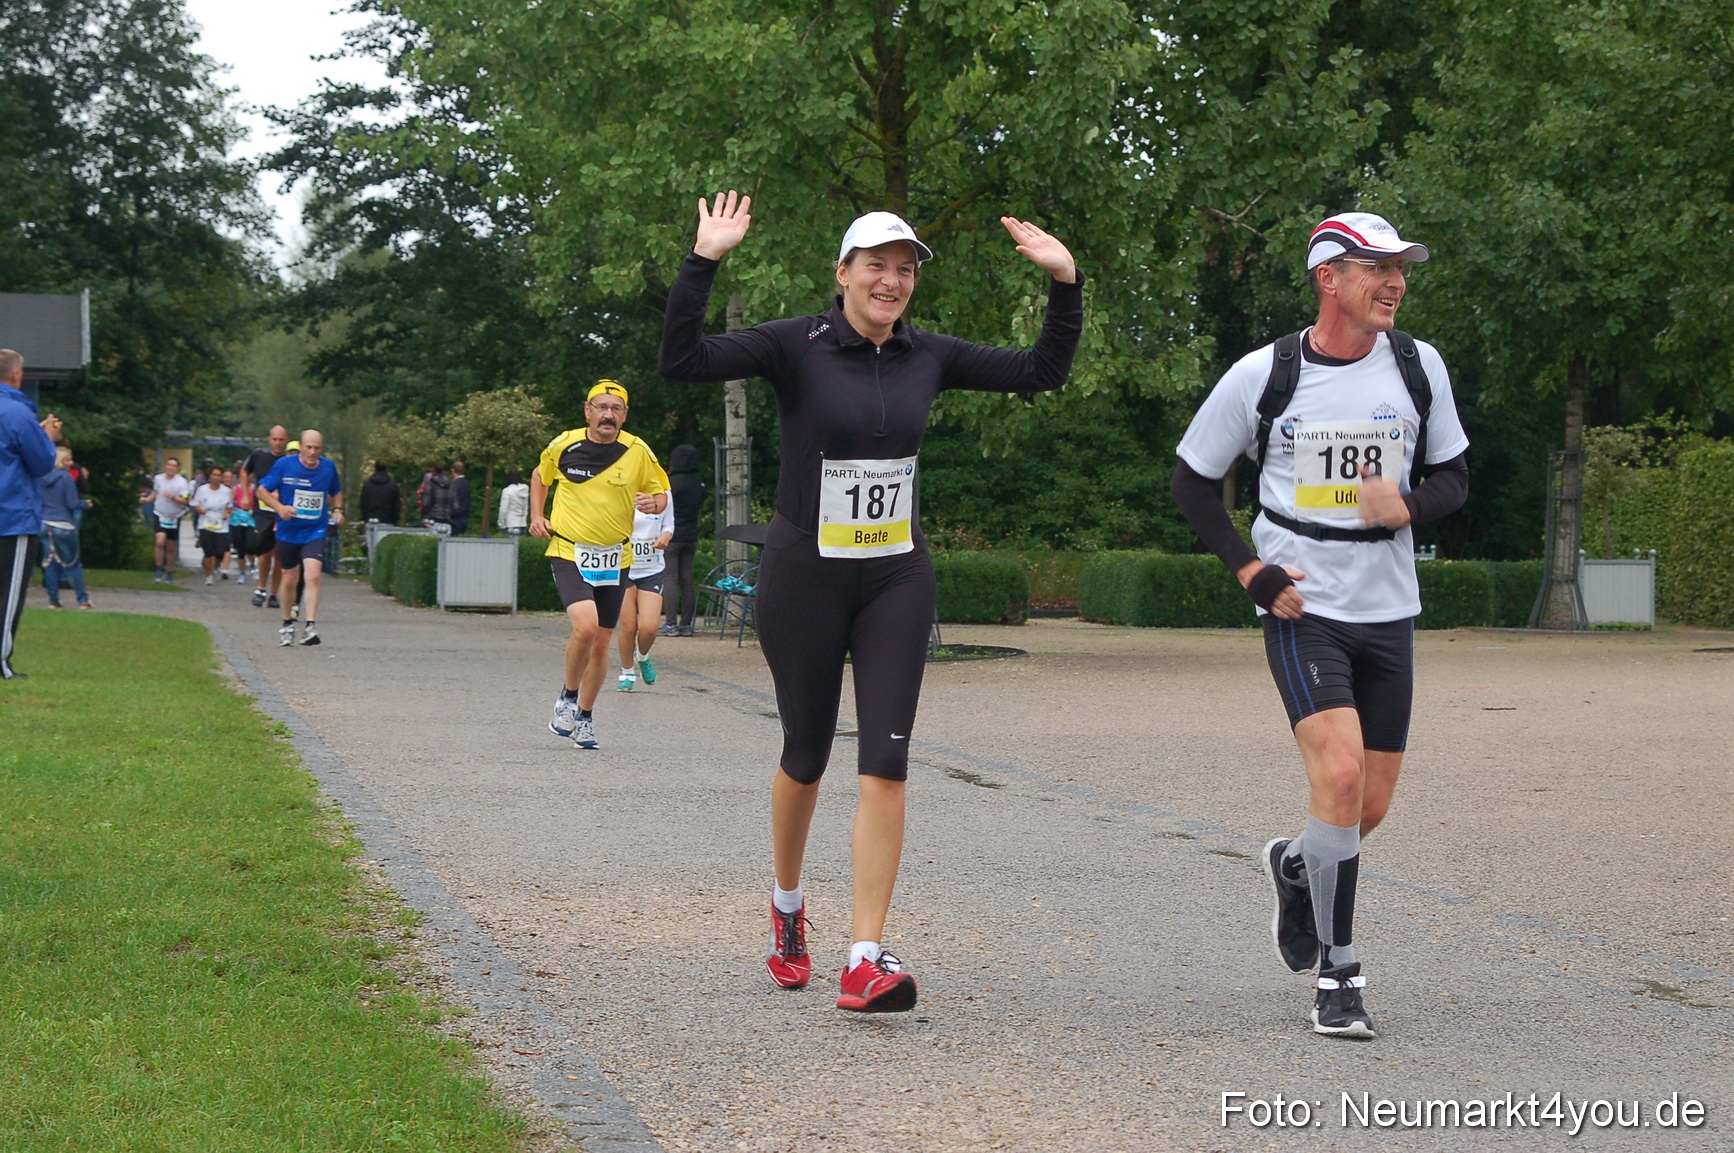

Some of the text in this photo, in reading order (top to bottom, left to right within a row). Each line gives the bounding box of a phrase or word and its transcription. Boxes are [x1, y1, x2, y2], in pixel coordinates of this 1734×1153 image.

[1297, 431, 1385, 440] PARTL Neumarkt
[1318, 445, 1382, 479] 188
[567, 467, 587, 476] Heinz
[825, 468, 903, 479] PARTL Neumarkt
[845, 483, 901, 519] 187
[854, 530, 888, 544] Beate
[580, 552, 618, 568] 2510
